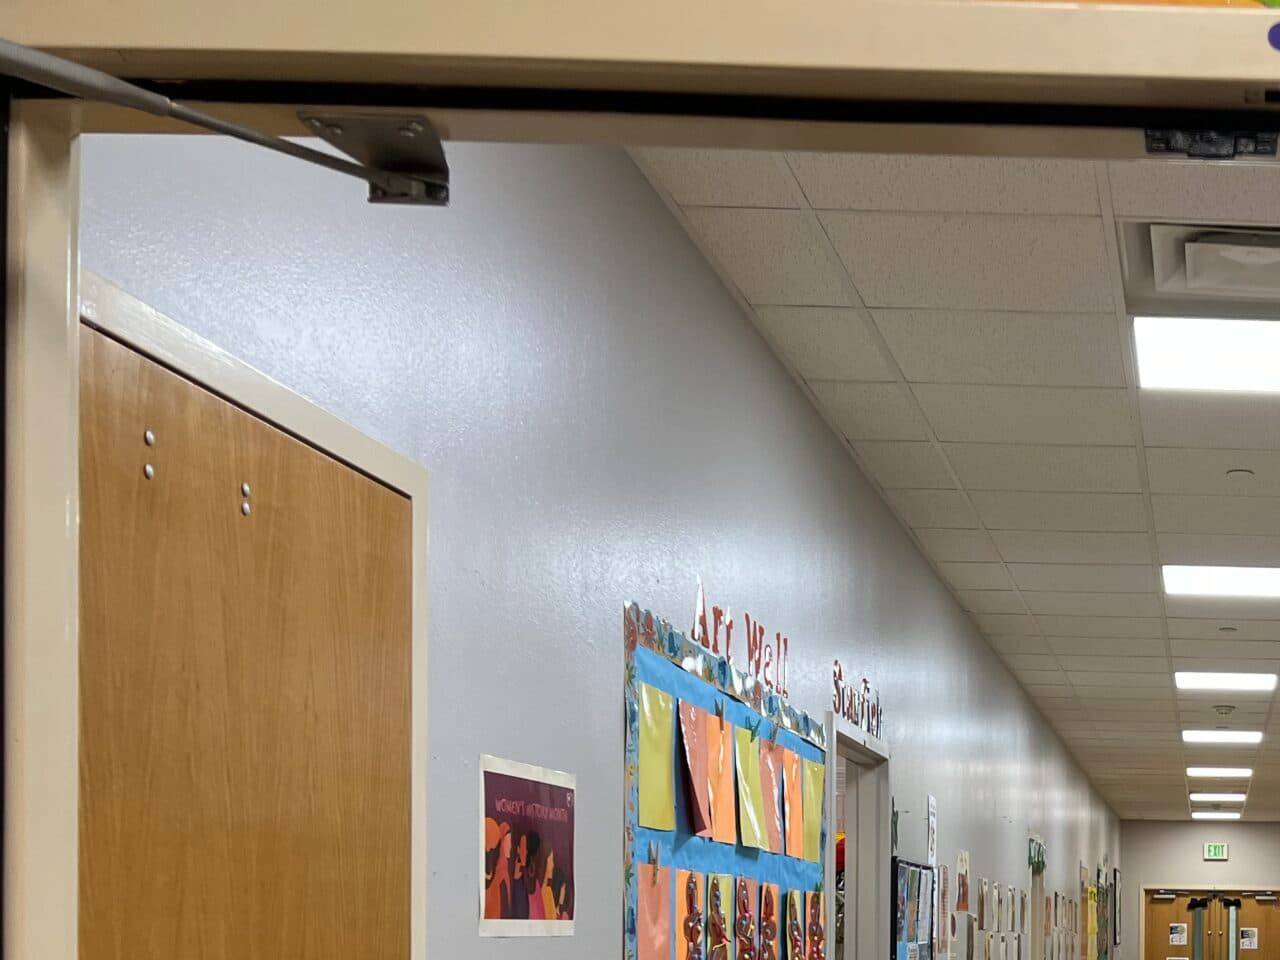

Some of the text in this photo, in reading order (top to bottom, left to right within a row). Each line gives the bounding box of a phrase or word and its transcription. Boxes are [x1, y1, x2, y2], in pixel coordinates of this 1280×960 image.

[691, 574, 789, 699] Art Wall
[1207, 844, 1225, 858] EXIT
